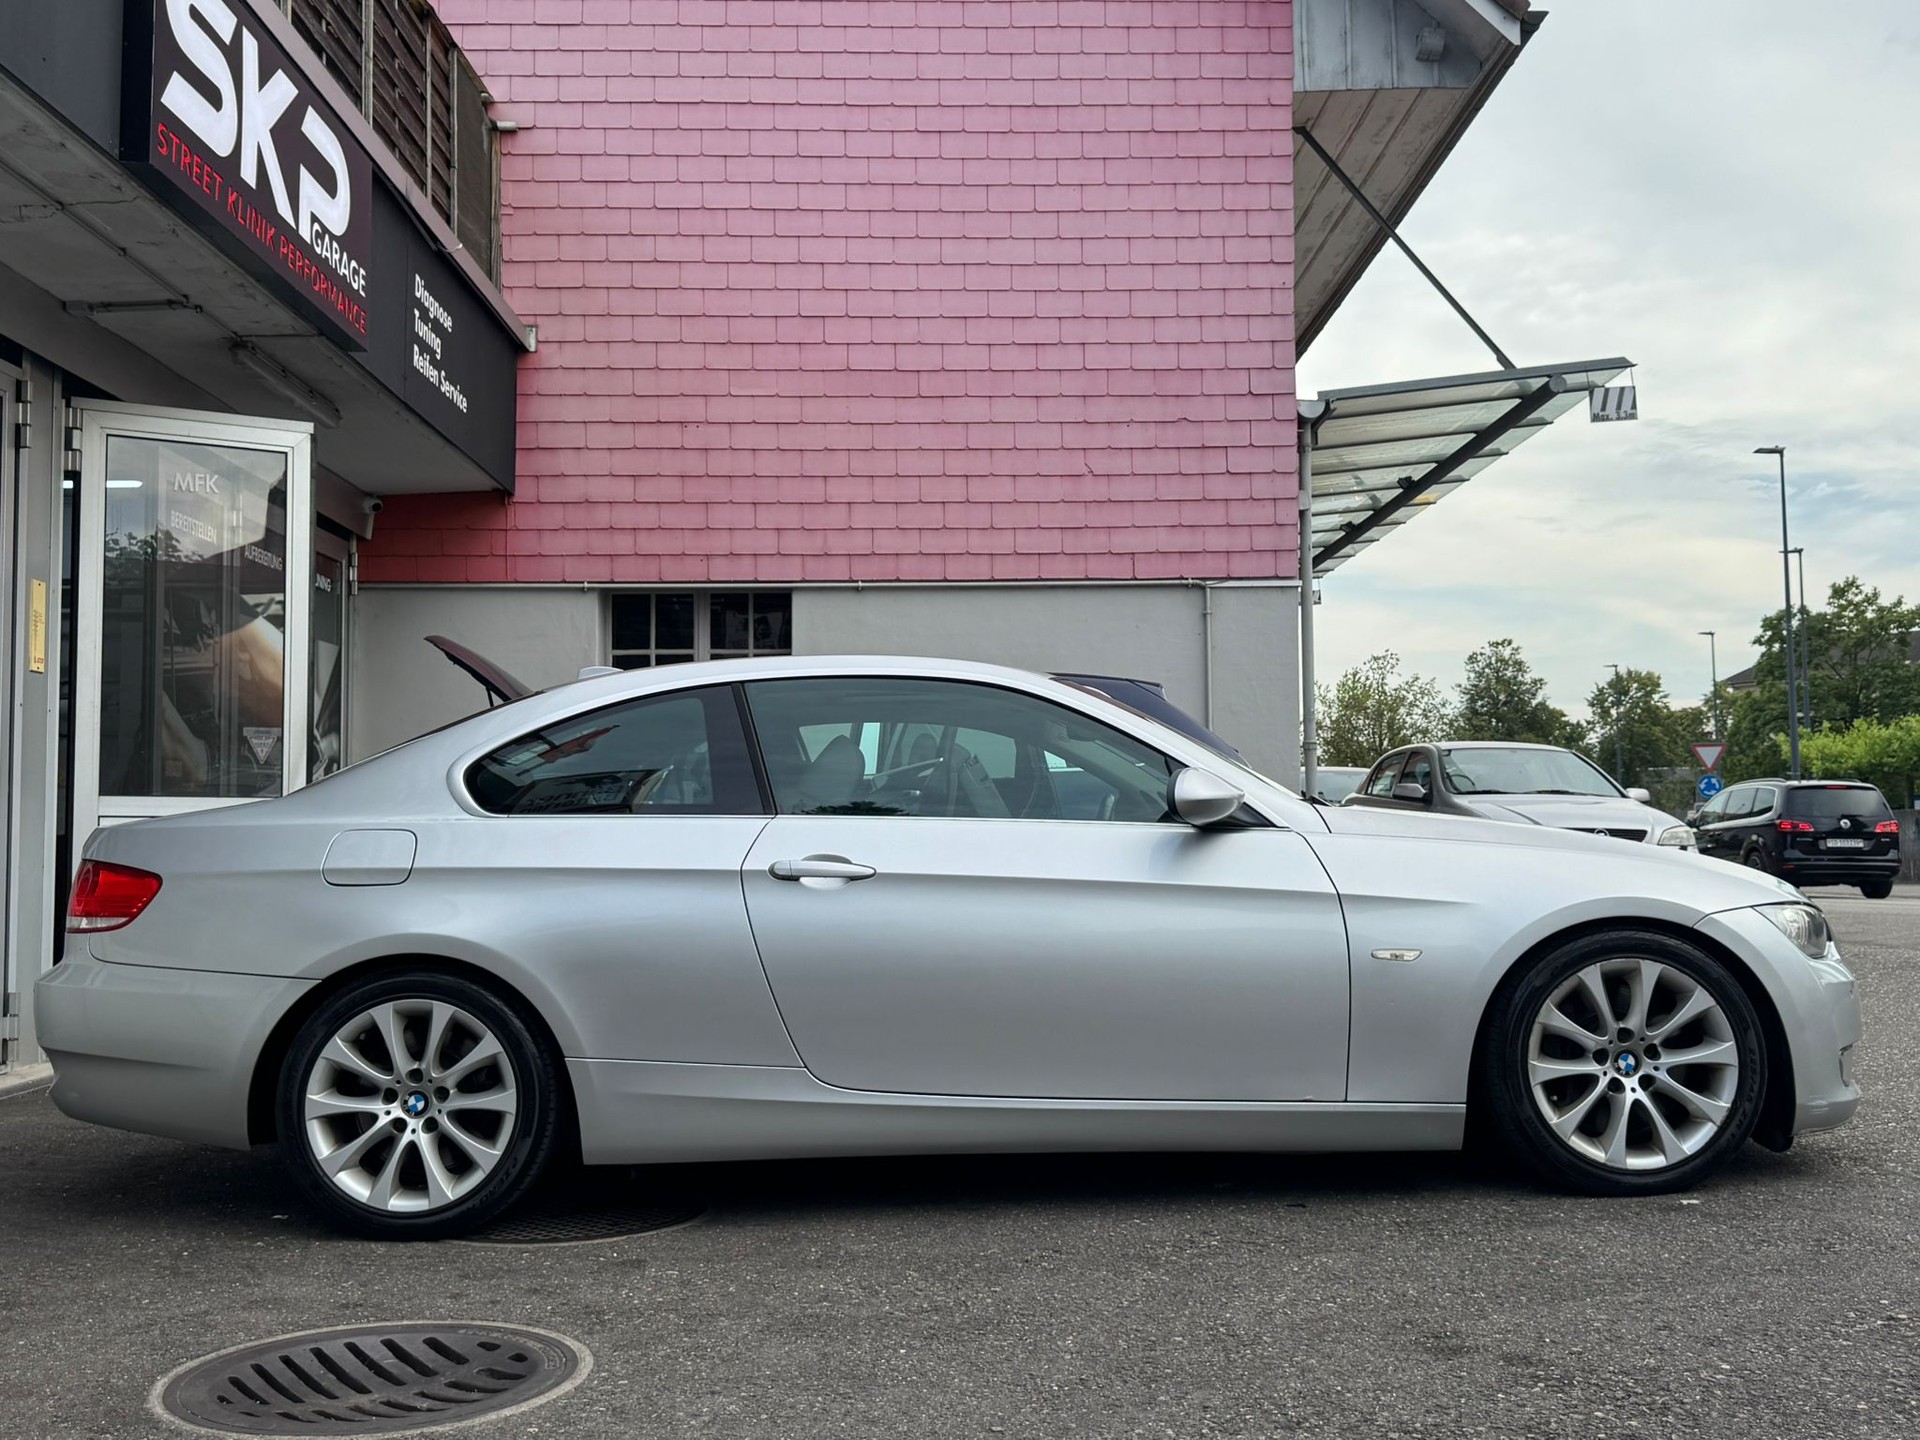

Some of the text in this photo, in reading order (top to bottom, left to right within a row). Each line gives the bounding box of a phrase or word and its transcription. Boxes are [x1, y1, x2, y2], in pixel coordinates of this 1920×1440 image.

[161, 0, 350, 245] SKP
[157, 122, 367, 334] STREET KLINIK PERFORMANCE
[312, 222, 366, 298] GARAGE
[414, 308, 441, 360] Tuning
[415, 273, 452, 333] Diagnose
[413, 344, 468, 413] Reifen Service
[173, 473, 220, 493] MFK
[171, 509, 217, 544] BEREITSTELLEN
